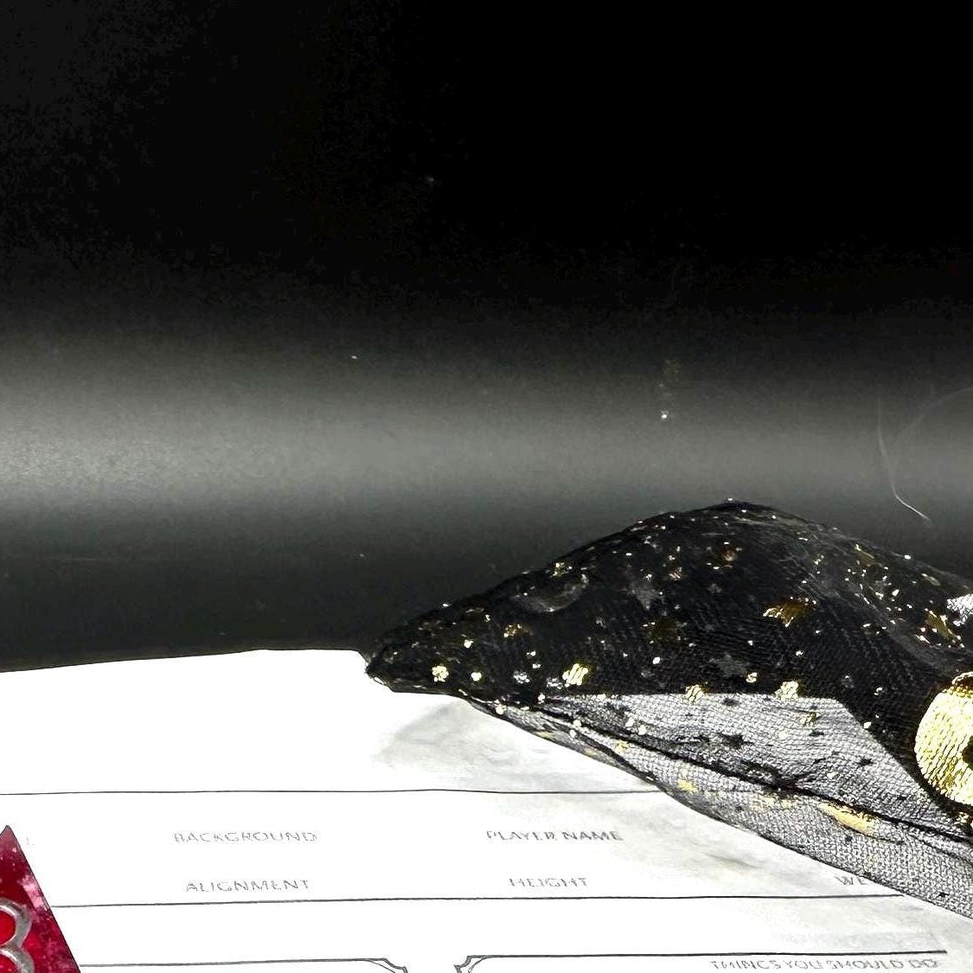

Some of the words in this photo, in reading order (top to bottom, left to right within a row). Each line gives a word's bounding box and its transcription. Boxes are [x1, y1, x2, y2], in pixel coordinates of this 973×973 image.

[173, 832, 318, 843] BACKGROUND
[486, 831, 557, 841] PLAYER
[562, 831, 624, 841] NAME
[186, 880, 309, 892] ALIGNMENT
[509, 878, 588, 888] HEIGHT
